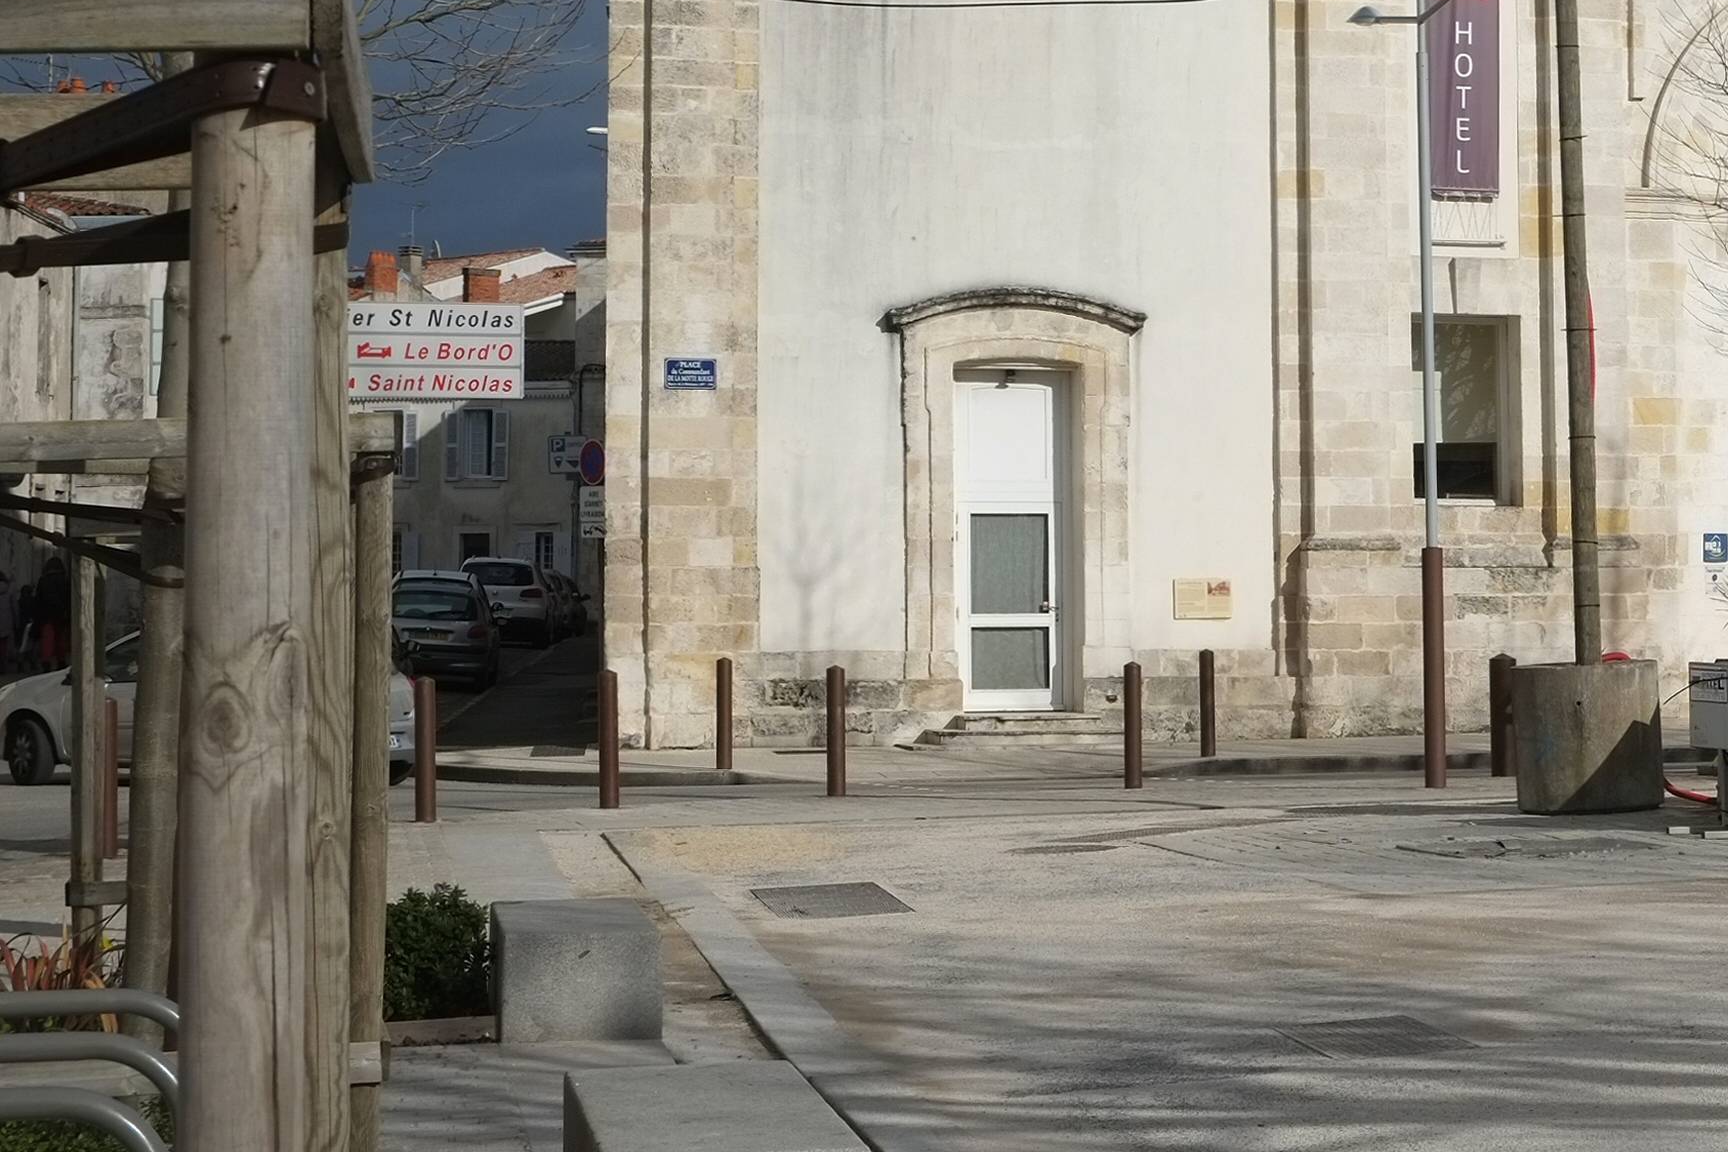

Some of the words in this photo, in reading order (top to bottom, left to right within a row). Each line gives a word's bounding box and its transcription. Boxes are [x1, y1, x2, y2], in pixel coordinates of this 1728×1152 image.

[1454, 21, 1473, 174] HOTEL
[389, 309, 413, 327] St
[427, 309, 514, 328] Nicolas
[404, 343, 429, 360] Le
[437, 343, 513, 361] Bord'O
[368, 374, 425, 392] Saint
[431, 375, 513, 393] Nicolas
